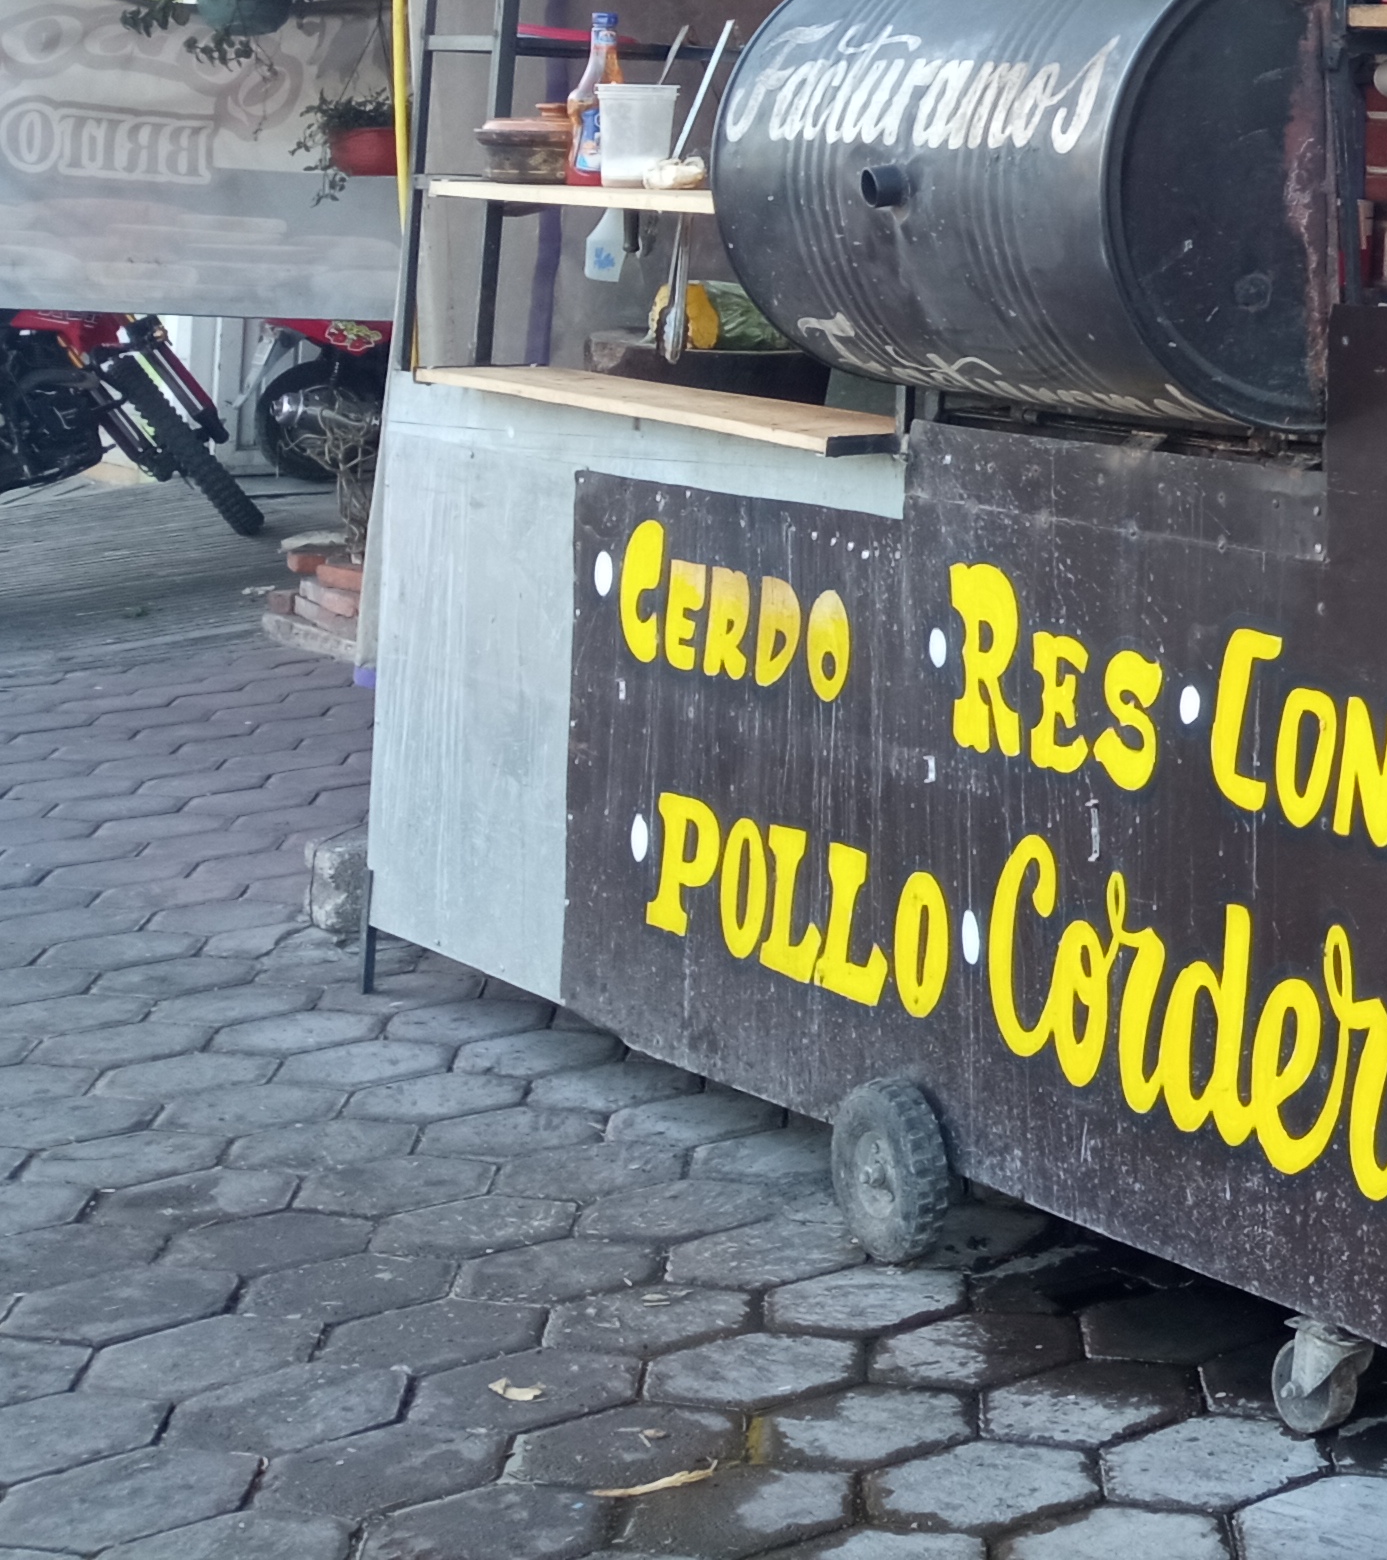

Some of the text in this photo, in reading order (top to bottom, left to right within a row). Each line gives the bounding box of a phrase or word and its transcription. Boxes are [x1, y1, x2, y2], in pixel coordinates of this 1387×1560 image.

[725, 19, 1121, 154] Facturamos
[619, 518, 850, 703] CERDO
[645, 791, 950, 1019] POLLO
